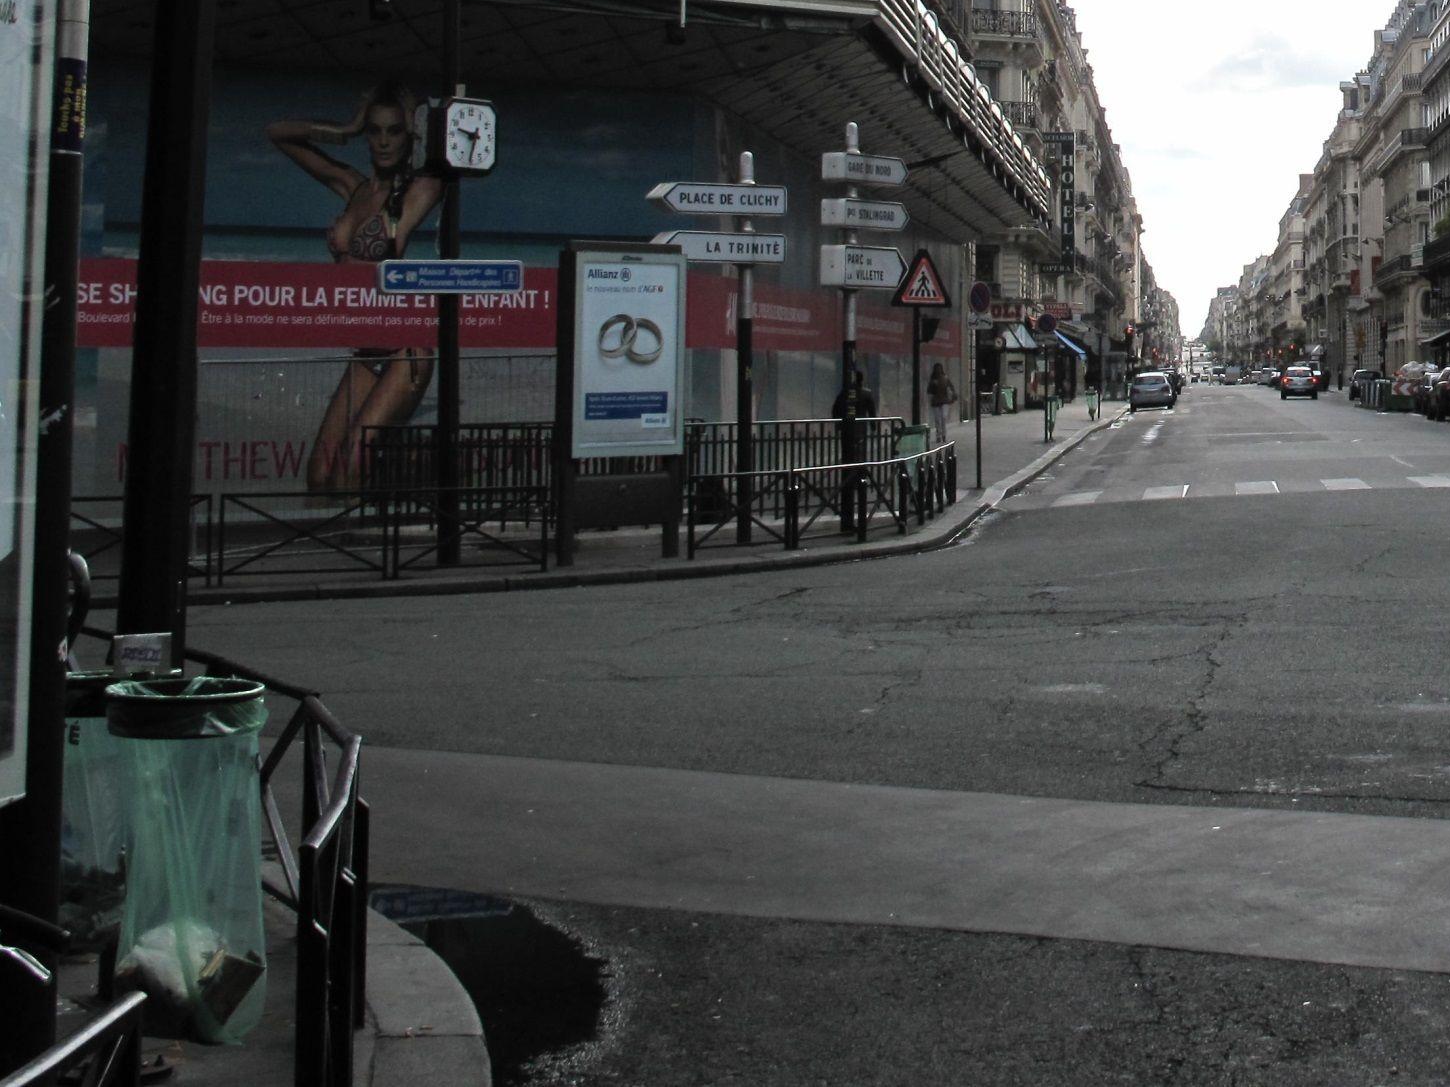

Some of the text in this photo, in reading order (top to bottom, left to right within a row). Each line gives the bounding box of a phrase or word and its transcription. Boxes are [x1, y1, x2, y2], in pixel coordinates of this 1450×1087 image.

[848, 161, 892, 176] GARE DU NORD
[680, 192, 779, 206] PLACE DE CLICHY
[1062, 154, 1074, 235] HOTEL
[859, 209, 895, 222] STALINGRAD
[706, 242, 780, 255] LA TRINITÉ
[847, 254, 864, 265] PARC
[418, 267, 446, 276] Maison
[587, 269, 619, 279] Allianz
[856, 270, 884, 281] VILLETTE
[418, 279, 456, 288] Personnes
[234, 284, 295, 306] POUR
[302, 286, 329, 307] LA
[334, 286, 409, 309] FEMME
[462, 290, 539, 310] ENFANT
[543, 290, 550, 309] !
[78, 311, 131, 324] Boulevard
[201, 310, 223, 324] Être
[224, 313, 233, 324] à
[234, 313, 244, 324] la
[246, 313, 273, 325] mode
[276, 315, 289, 325] ne
[291, 316, 312, 325] sera
[314, 313, 382, 326] définitivement
[385, 317, 403, 328] pas
[404, 317, 421, 326] une
[465, 315, 477, 326] de
[478, 316, 496, 328] prix
